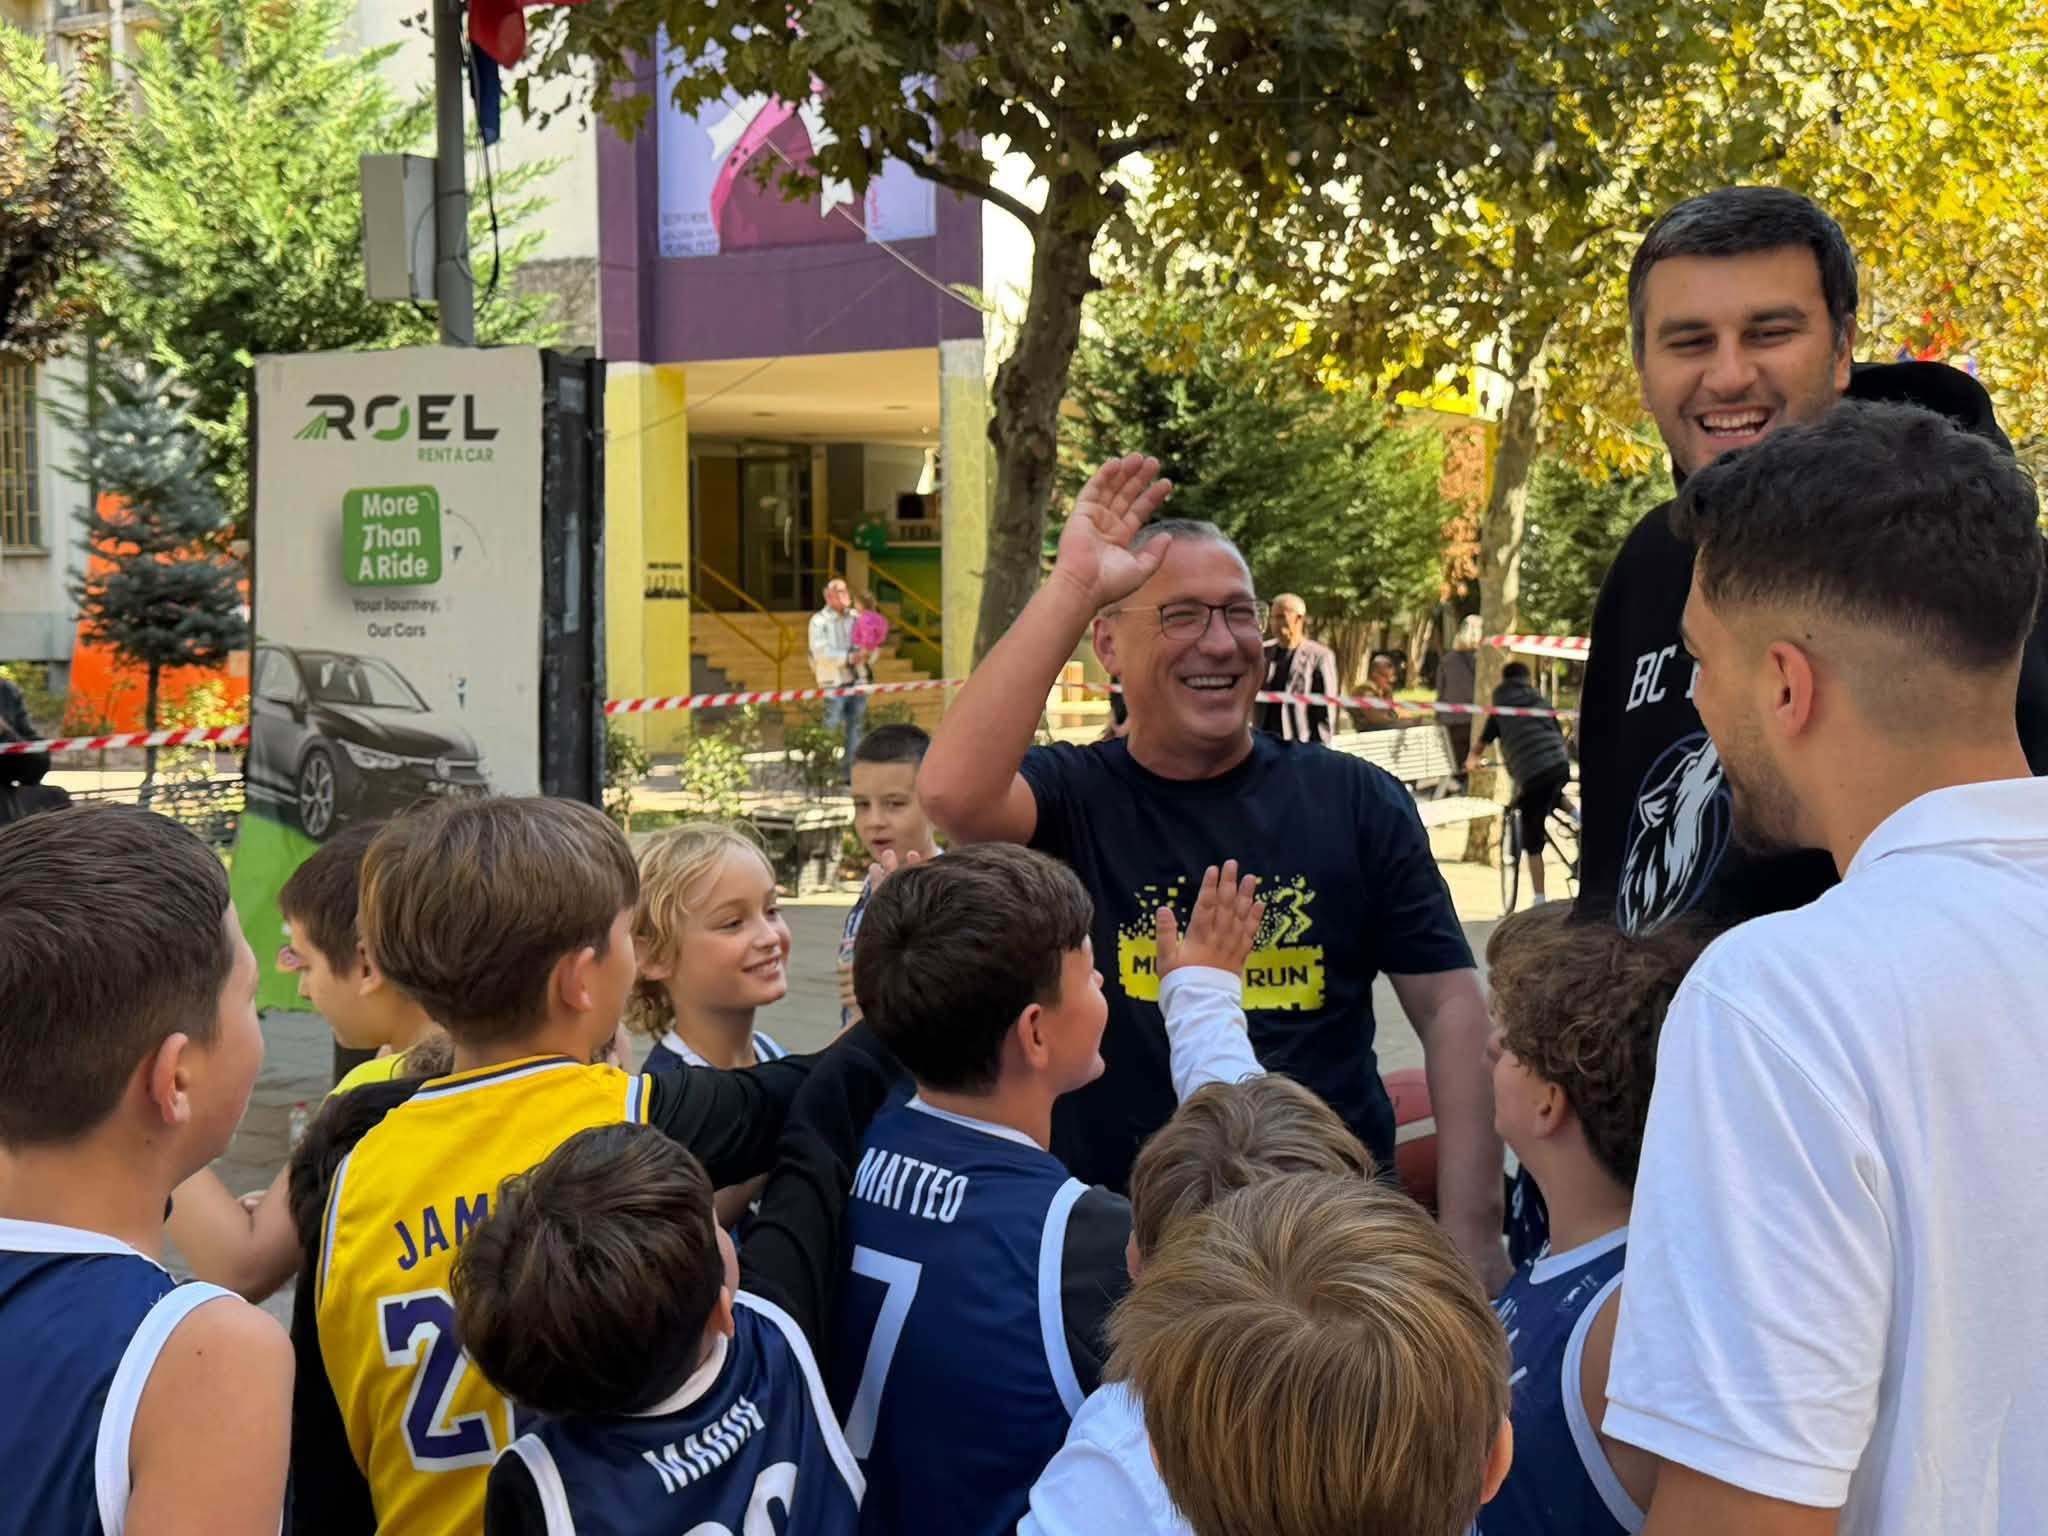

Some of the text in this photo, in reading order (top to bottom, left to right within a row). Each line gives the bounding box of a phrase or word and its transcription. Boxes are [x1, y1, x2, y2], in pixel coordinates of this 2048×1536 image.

[293, 394, 500, 441] ROEL
[417, 448, 454, 463] RENT
[465, 448, 494, 463] CAR
[362, 494, 419, 518] More
[362, 523, 421, 552] Than
[359, 551, 428, 580] A Ride
[353, 599, 382, 613] Your
[368, 622, 426, 638] Our Cars
[1625, 644, 1677, 712] BC
[1246, 966, 1308, 987] RUN
[850, 1147, 968, 1224] MATTEO
[394, 1193, 488, 1271] JAM
[842, 1245, 922, 1460] 7
[377, 1287, 515, 1473] 2
[641, 1395, 765, 1493] MARIN
